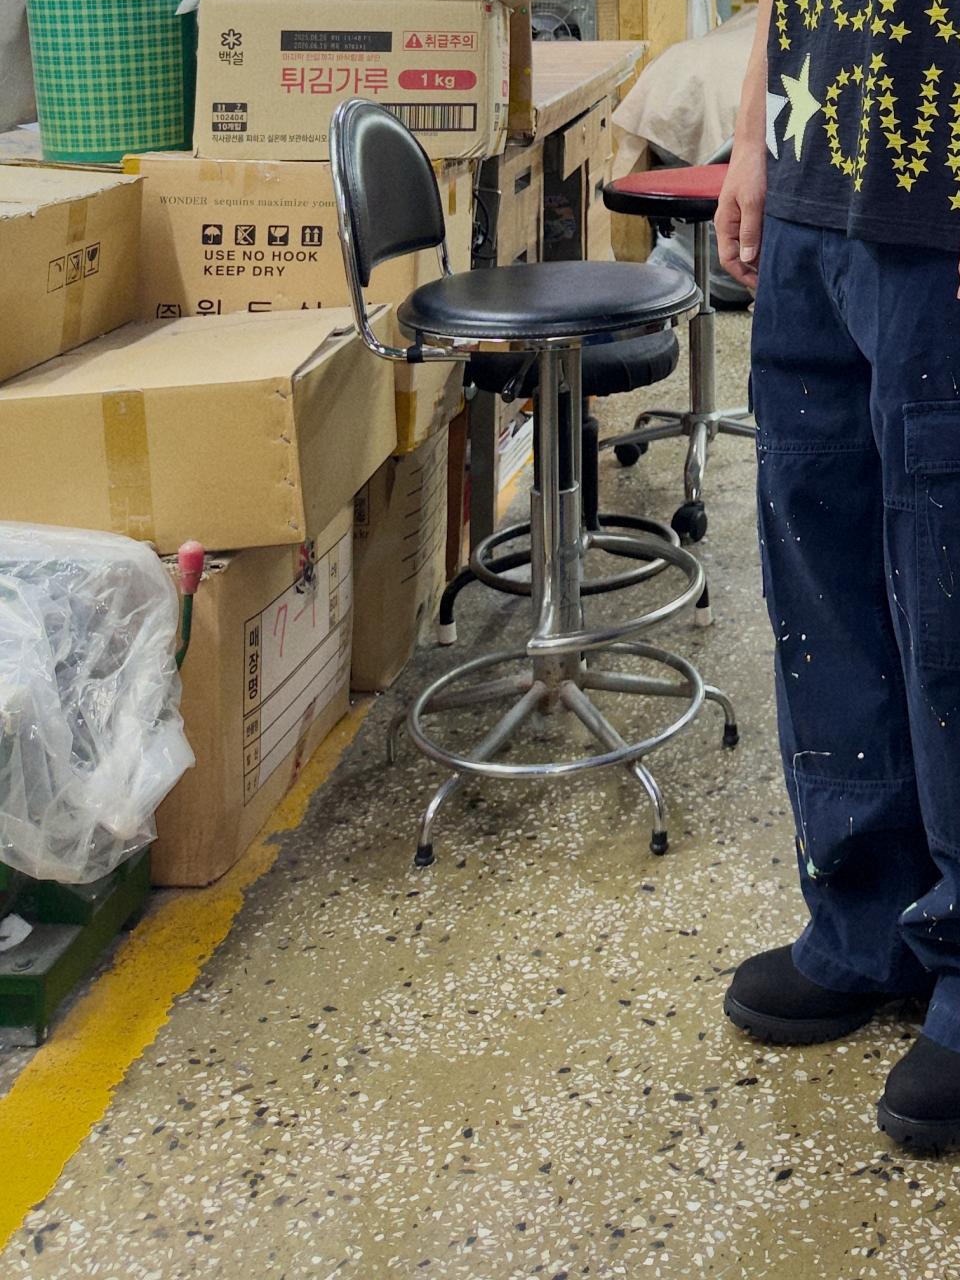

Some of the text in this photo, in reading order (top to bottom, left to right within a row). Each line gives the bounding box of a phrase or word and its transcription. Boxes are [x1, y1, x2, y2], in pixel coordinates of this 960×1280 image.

[425, 34, 474, 49] 취급주의
[218, 51, 244, 66] 백설
[280, 67, 389, 95] 튀김가루
[421, 73, 456, 88] 1 kg
[159, 196, 208, 205] WONDER
[214, 197, 255, 208] sequins
[204, 250, 318, 262] USE NO HOOK
[203, 265, 285, 276] KEEP DRY
